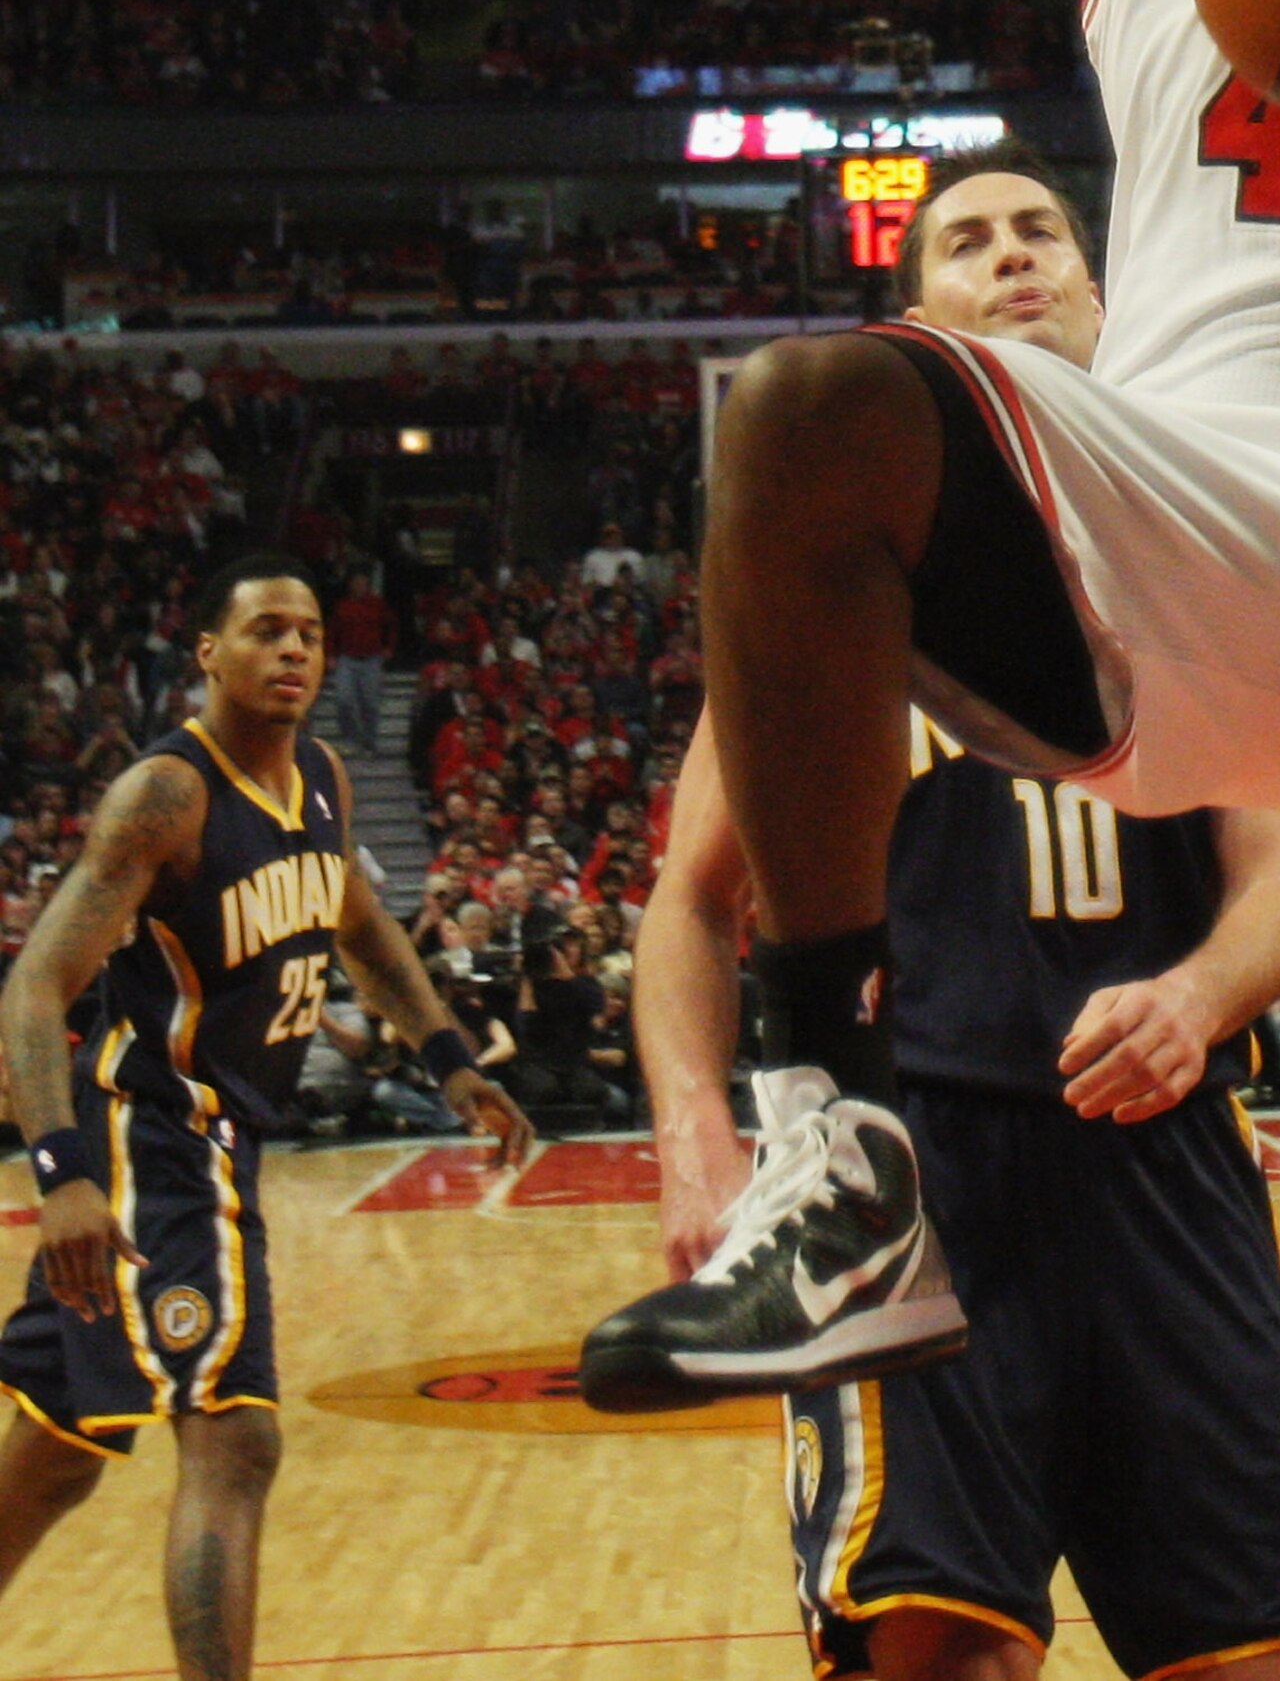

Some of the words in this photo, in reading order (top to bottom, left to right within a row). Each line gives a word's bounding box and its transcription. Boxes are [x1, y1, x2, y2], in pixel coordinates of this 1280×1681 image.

[842, 158, 926, 201] 6:29
[1012, 777, 1124, 920] 10
[264, 953, 330, 1046] 25
